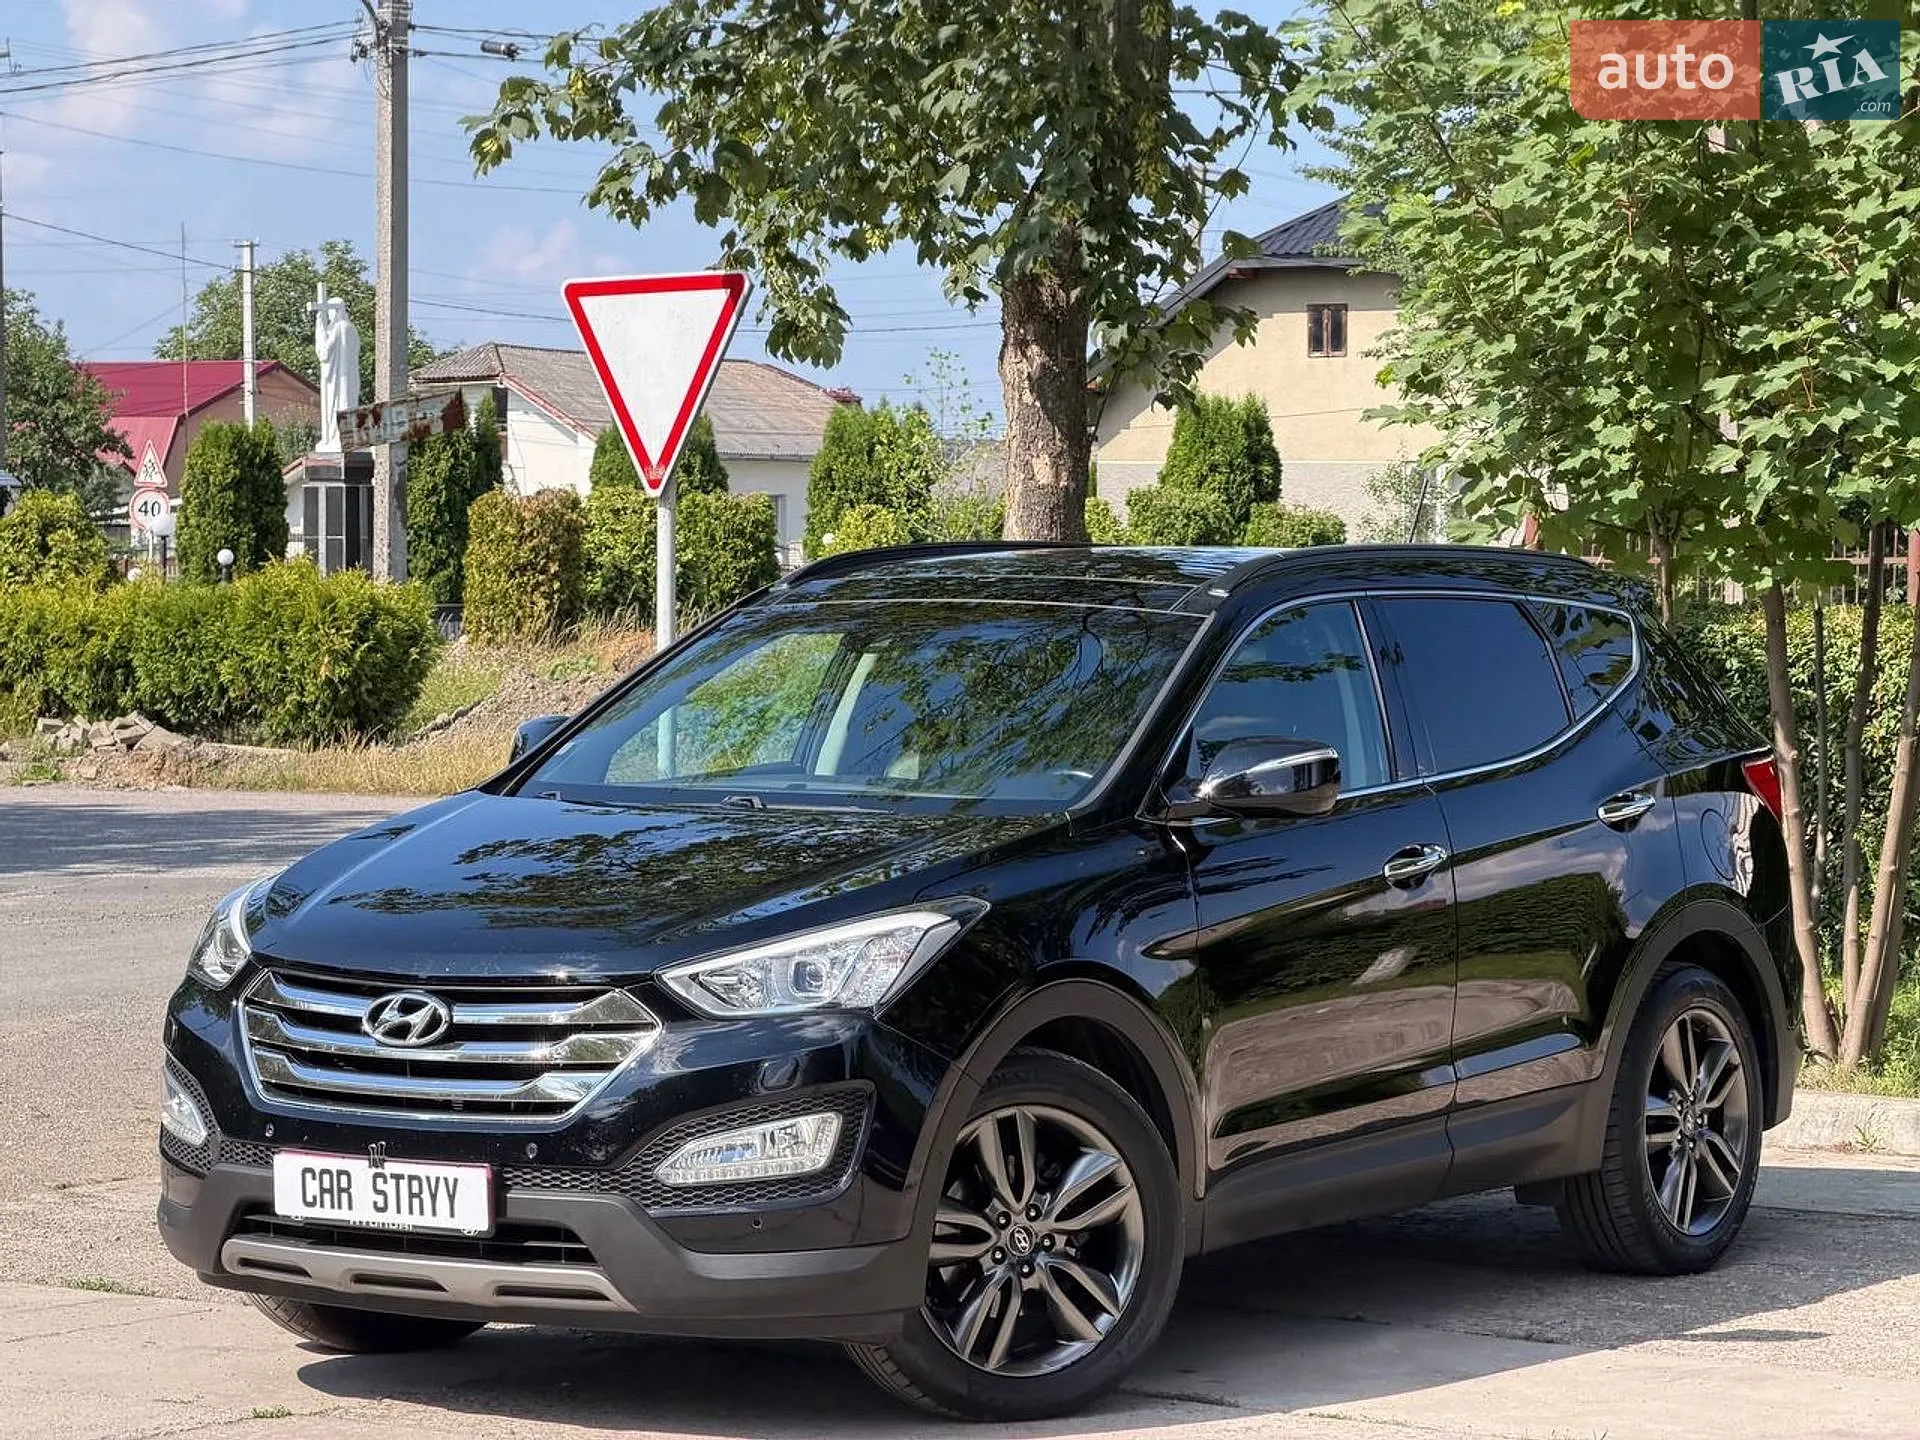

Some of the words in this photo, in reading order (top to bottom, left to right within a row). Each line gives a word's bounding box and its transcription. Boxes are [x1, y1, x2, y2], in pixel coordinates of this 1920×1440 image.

[138, 500, 161, 517] 40
[301, 1167, 353, 1211] CAR
[372, 1172, 459, 1219] STRYY
